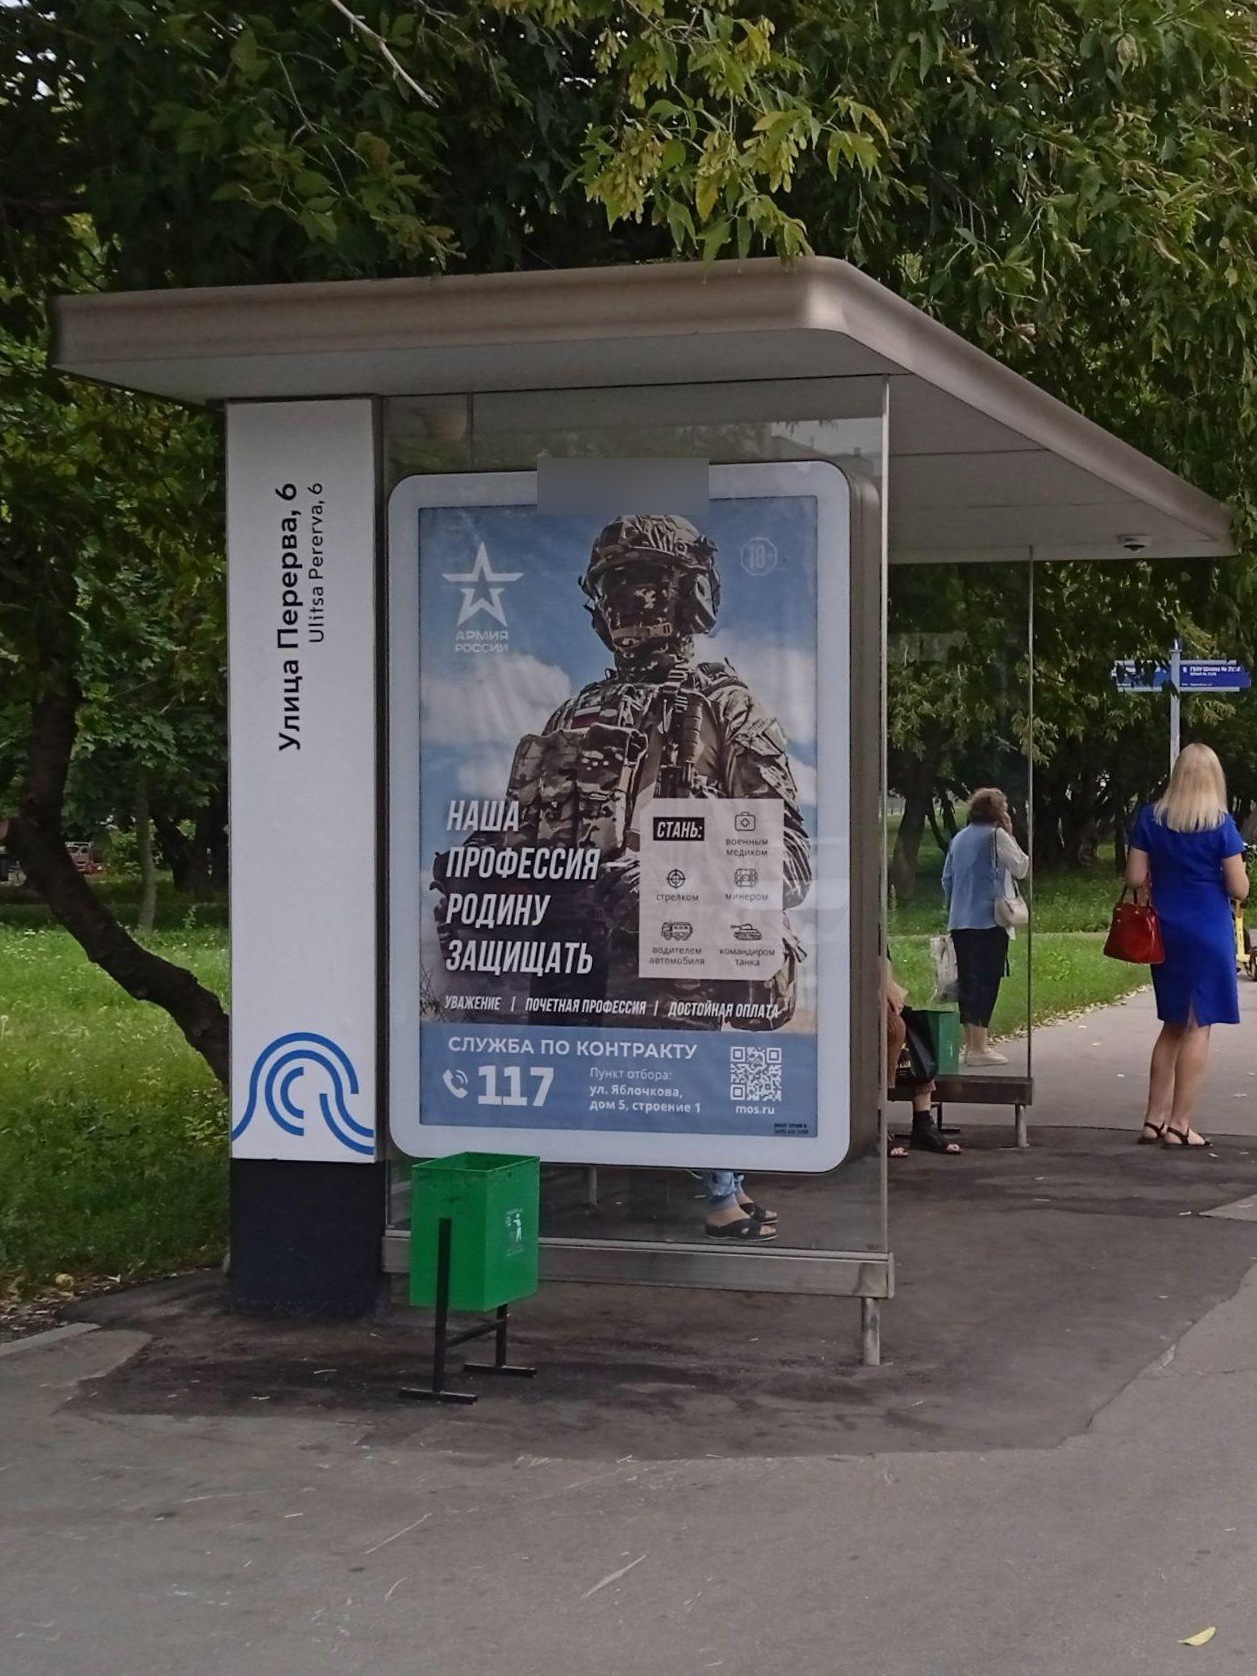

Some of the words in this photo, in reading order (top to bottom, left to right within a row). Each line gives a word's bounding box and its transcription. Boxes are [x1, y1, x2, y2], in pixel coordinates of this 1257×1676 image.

[275, 483, 297, 501] 6
[307, 483, 322, 495] 6
[308, 500, 325, 580] Pererva,
[276, 509, 303, 649] Перерва,
[308, 586, 324, 643] Ulitsa
[455, 630, 508, 641] АРМИЯ
[455, 643, 509, 653] РОССИИ
[279, 659, 303, 751] Улица
[447, 800, 519, 831] НАША
[656, 821, 703, 839] СТАНЬ:
[725, 838, 768, 846] военным
[726, 849, 768, 858] медиком
[446, 847, 601, 880] ПРОФЕССИЯ
[656, 893, 699, 902] стрелком
[725, 893, 768, 902] минером
[446, 893, 551, 928] РОДИНУ
[446, 940, 593, 976] ЗАЩИЩАТЬ
[652, 945, 702, 955] водителем
[719, 947, 775, 957] командиром
[649, 956, 705, 966] автомобиля
[735, 957, 760, 967] танка
[444, 995, 502, 1011] УВАЖЕНИЕ
[525, 997, 580, 1013] ПОЧЕТНАЯ
[581, 999, 647, 1015] ПРОФЕССИЯ
[667, 1001, 733, 1018] ДОСТОЙНАЯ
[735, 1003, 780, 1019] ОПЛАТА
[448, 1036, 534, 1055] СЛУЖБА
[540, 1039, 570, 1056] ПО
[576, 1041, 698, 1060] КОНТРАКТУ
[590, 1067, 624, 1080] Пункт
[627, 1069, 673, 1083] отбора:
[477, 1065, 555, 1107] 117
[590, 1085, 608, 1096] ул.
[611, 1085, 684, 1100] Яблочкова,
[589, 1100, 616, 1112] дом
[618, 1100, 629, 1112] 5,
[632, 1103, 691, 1114] строение
[694, 1103, 702, 1114] 1
[735, 1104, 776, 1115] mos.ru
